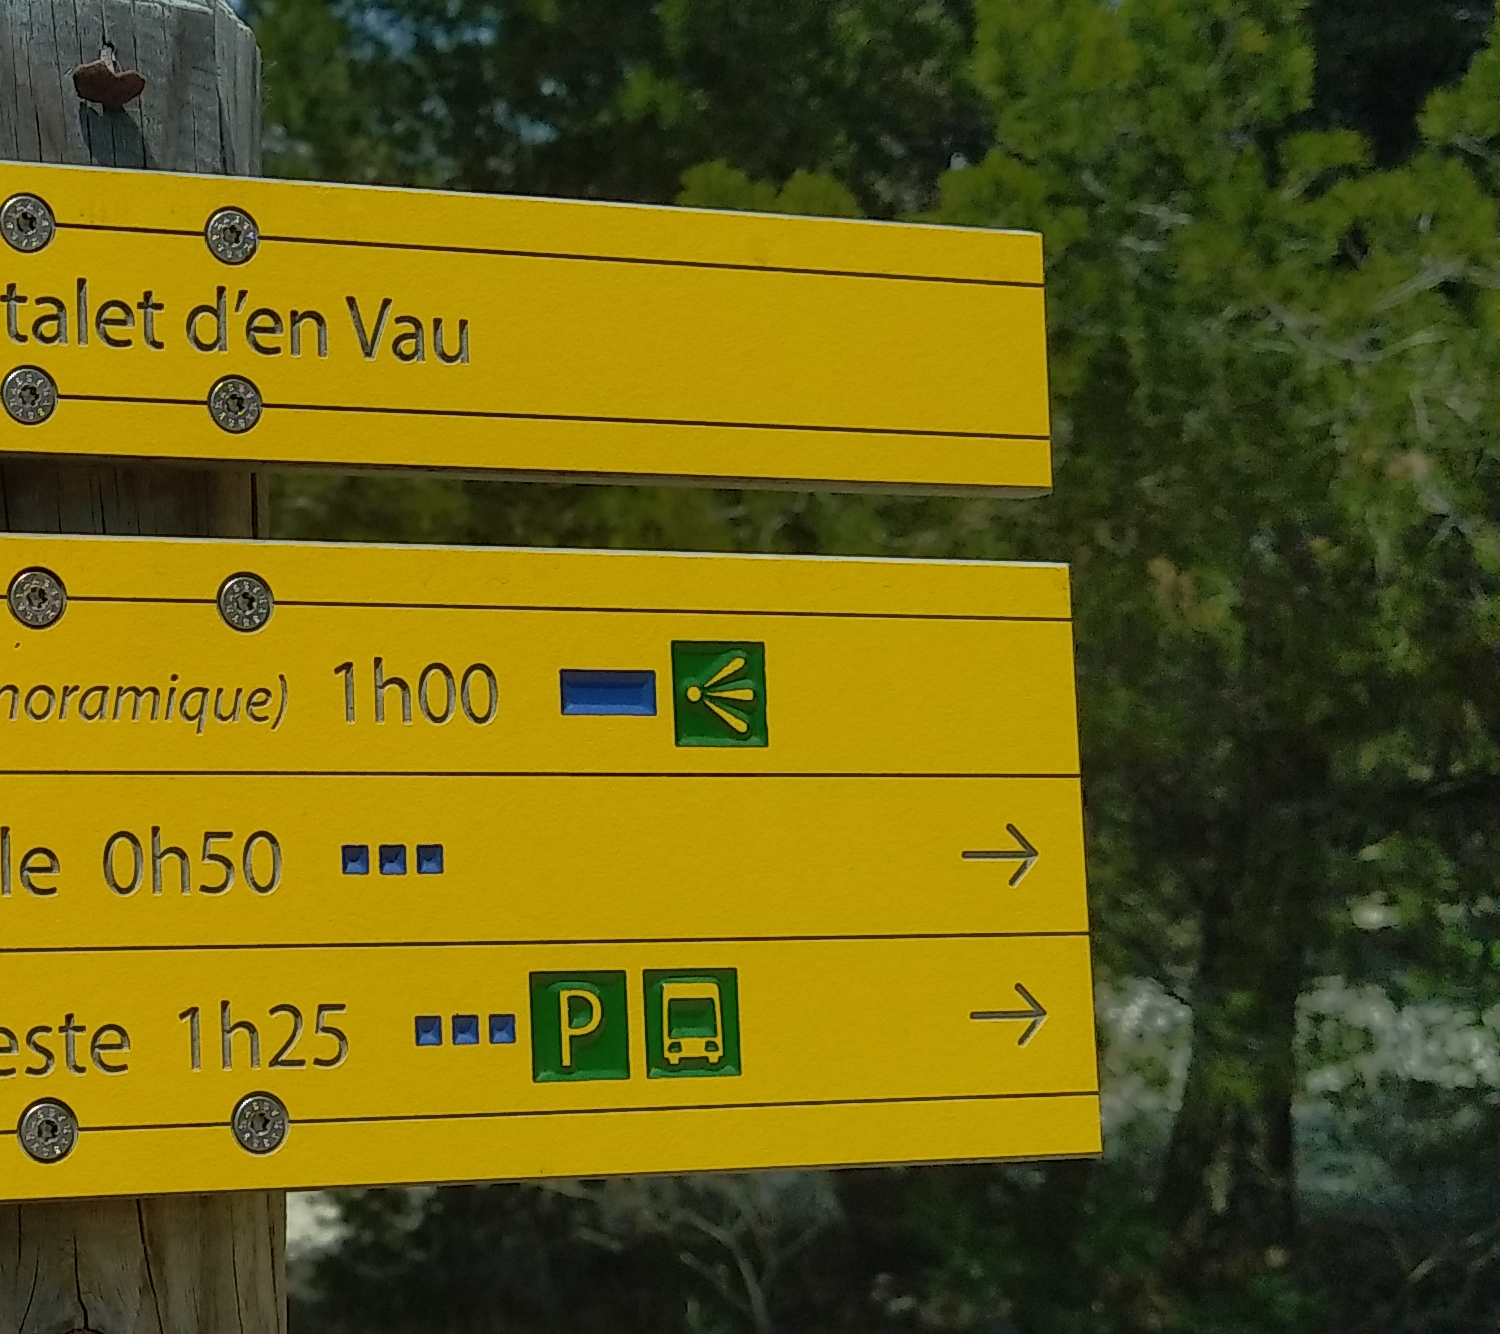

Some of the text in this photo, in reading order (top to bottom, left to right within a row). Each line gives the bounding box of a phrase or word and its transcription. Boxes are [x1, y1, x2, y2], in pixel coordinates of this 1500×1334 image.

[185, 283, 329, 358] d'en
[345, 295, 473, 365] Vau
[333, 657, 500, 727] 1h00
[102, 825, 283, 898] 0h50
[177, 1001, 351, 1074] 1h25
[558, 987, 604, 1070] P
